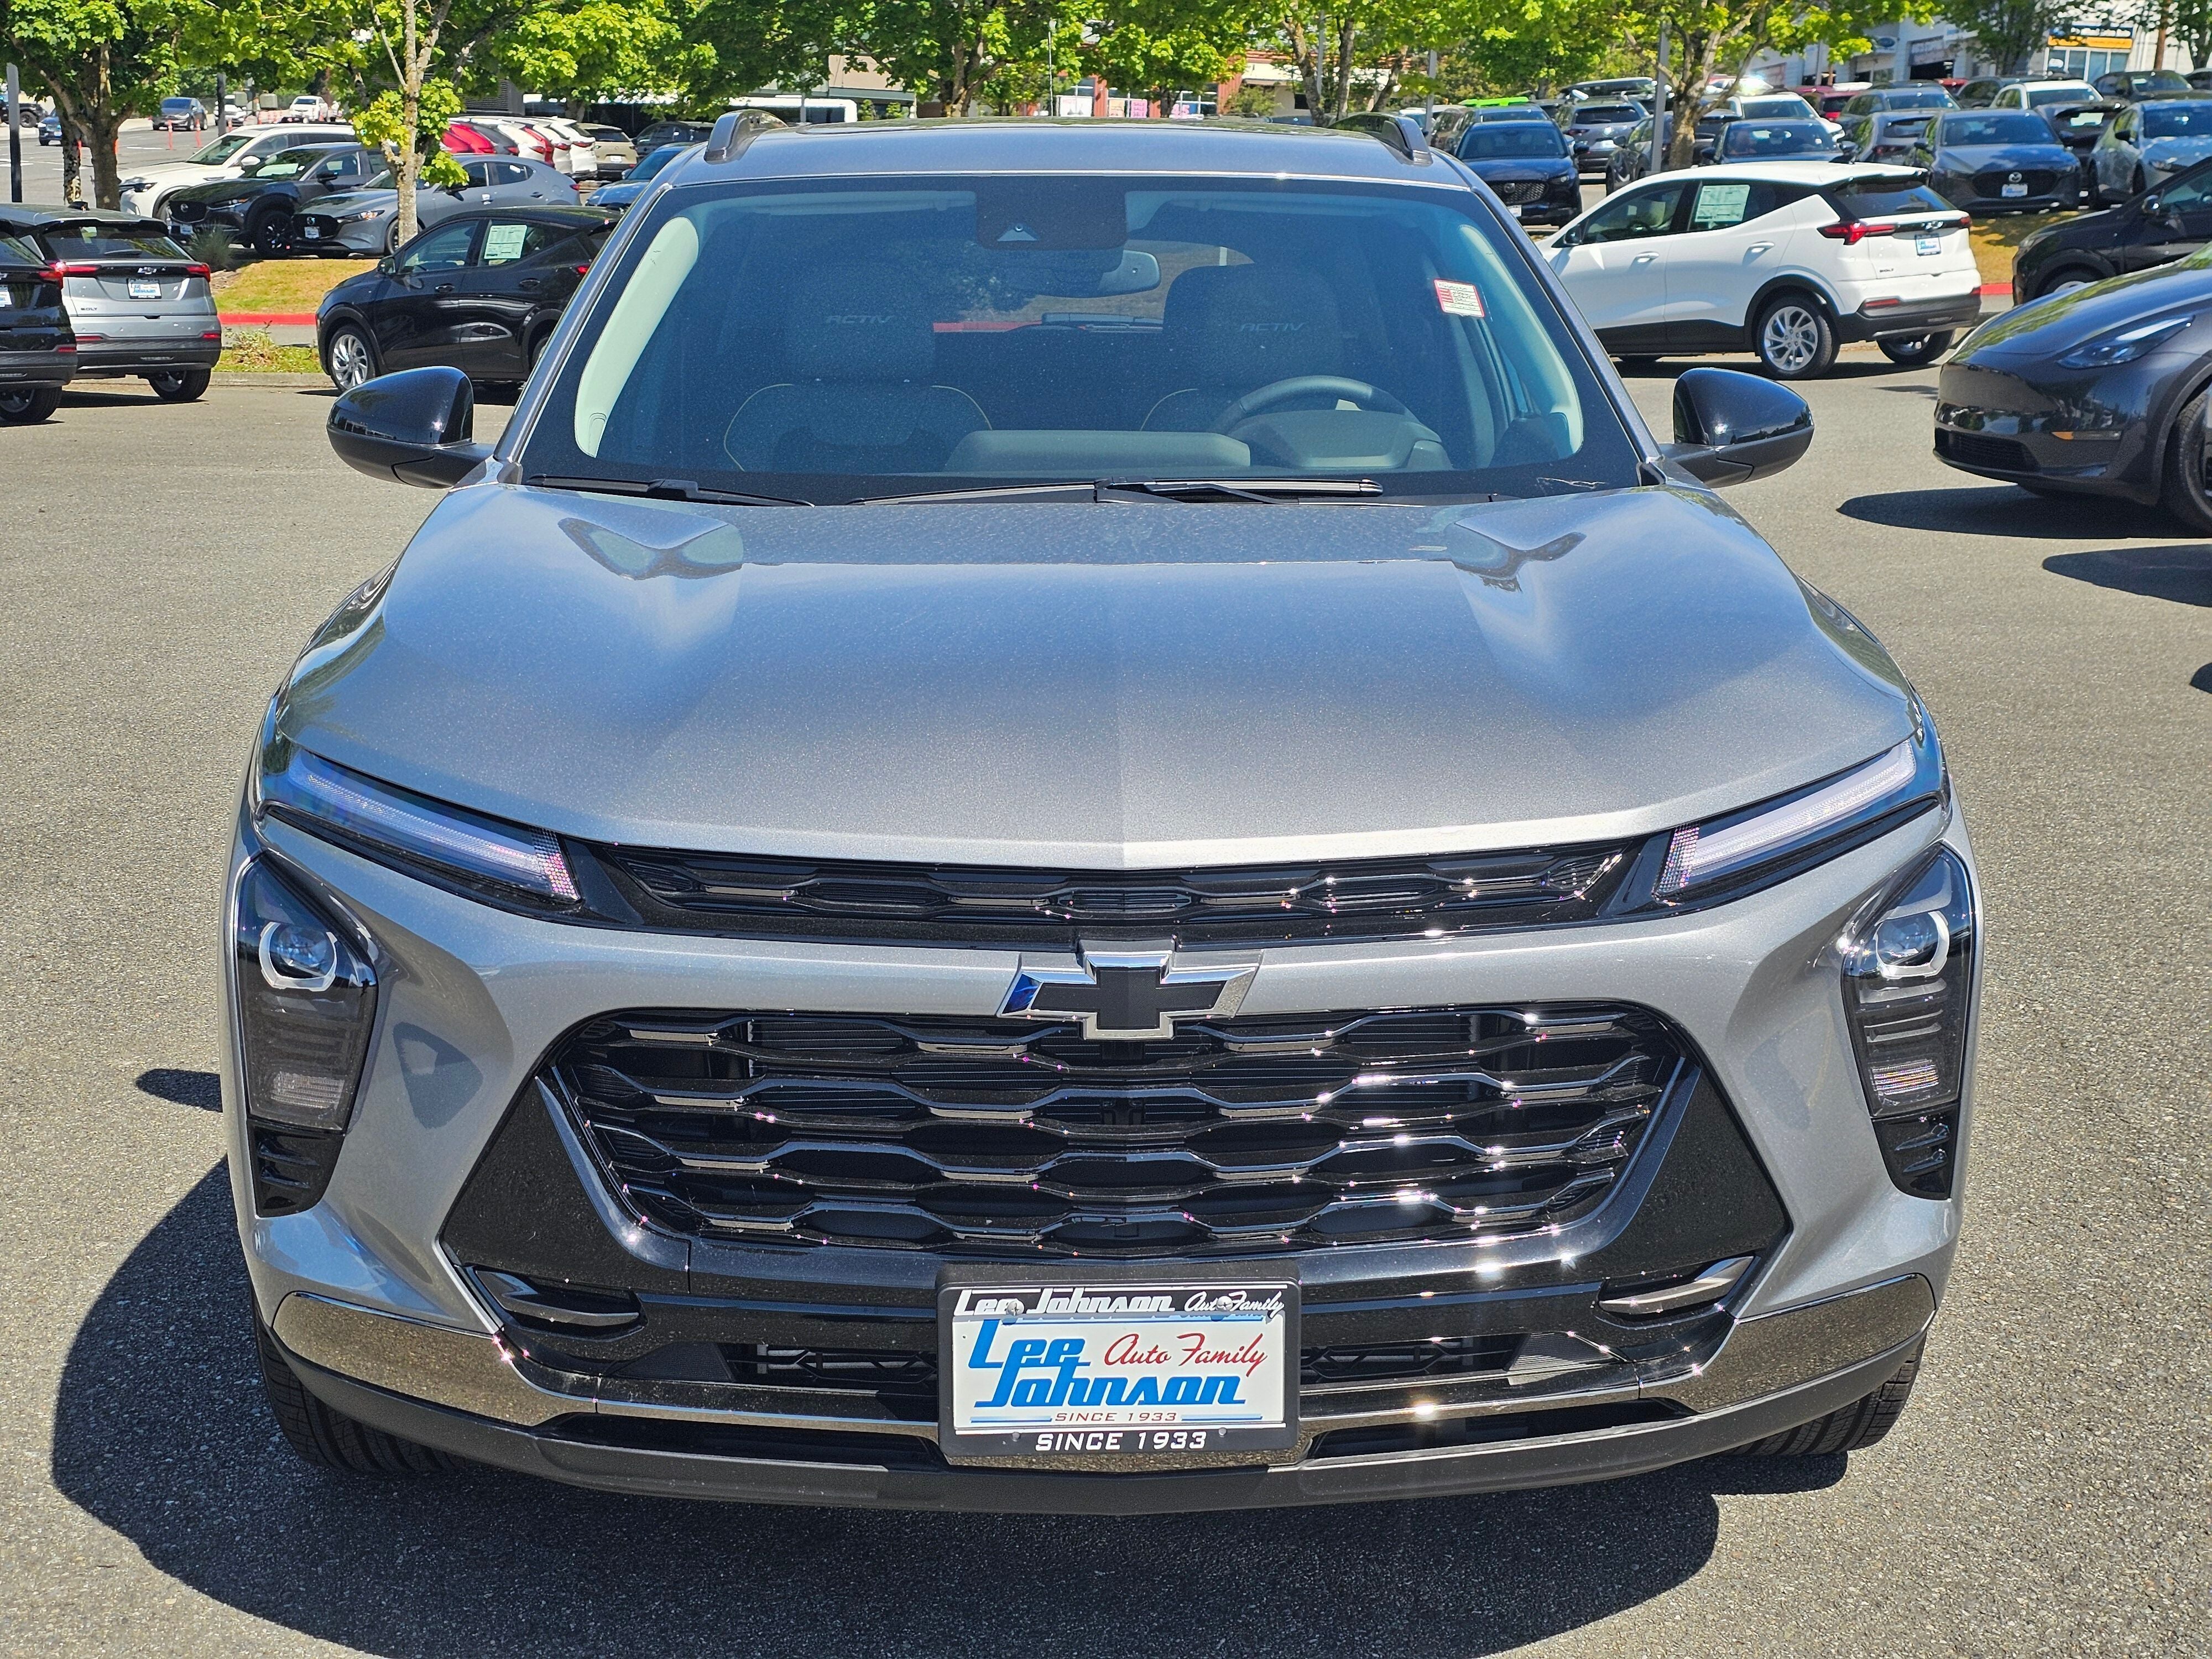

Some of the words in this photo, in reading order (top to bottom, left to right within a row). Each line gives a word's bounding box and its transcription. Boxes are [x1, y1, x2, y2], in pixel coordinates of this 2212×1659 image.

[826, 315, 895, 324] ACTIV
[1239, 322, 1306, 332] ACTIV
[1026, 1287, 1176, 1313] Johnson
[1184, 1291, 1223, 1312] Aut
[1228, 1290, 1285, 1318] Family
[968, 1319, 1091, 1369] Lee
[1104, 1333, 1172, 1365] Auto
[1176, 1333, 1268, 1377] Family
[974, 1365, 1246, 1407] Johnson
[1055, 1412, 1118, 1422] SINCE
[1128, 1412, 1177, 1421] 1933
[1035, 1432, 1123, 1452] SINCE
[1137, 1431, 1207, 1450] 1933
